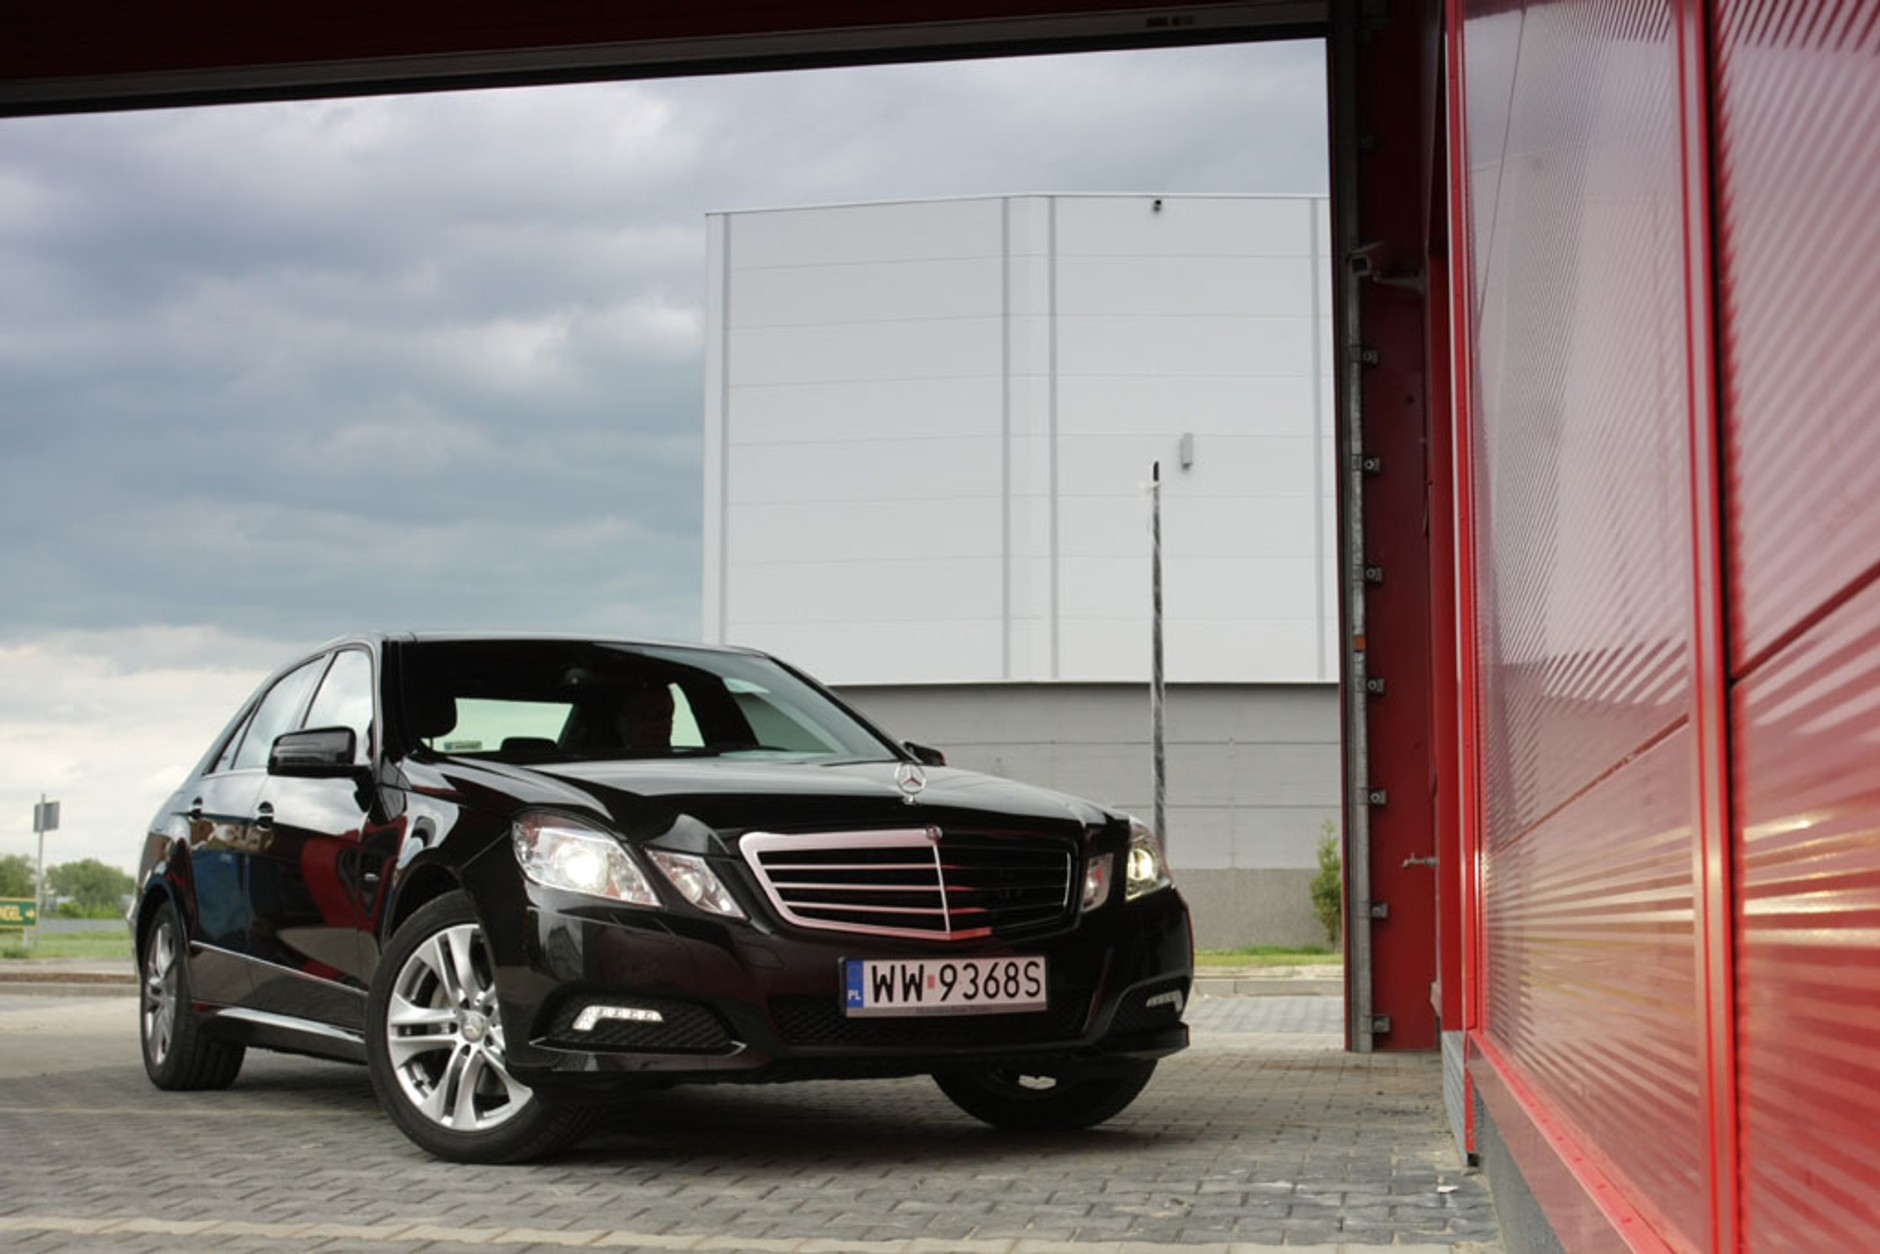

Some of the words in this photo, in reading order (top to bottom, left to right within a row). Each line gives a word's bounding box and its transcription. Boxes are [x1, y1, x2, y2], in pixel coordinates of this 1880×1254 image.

[848, 989, 861, 1000] PL
[872, 964, 923, 1003] WW
[939, 961, 1041, 1001] 9368S
